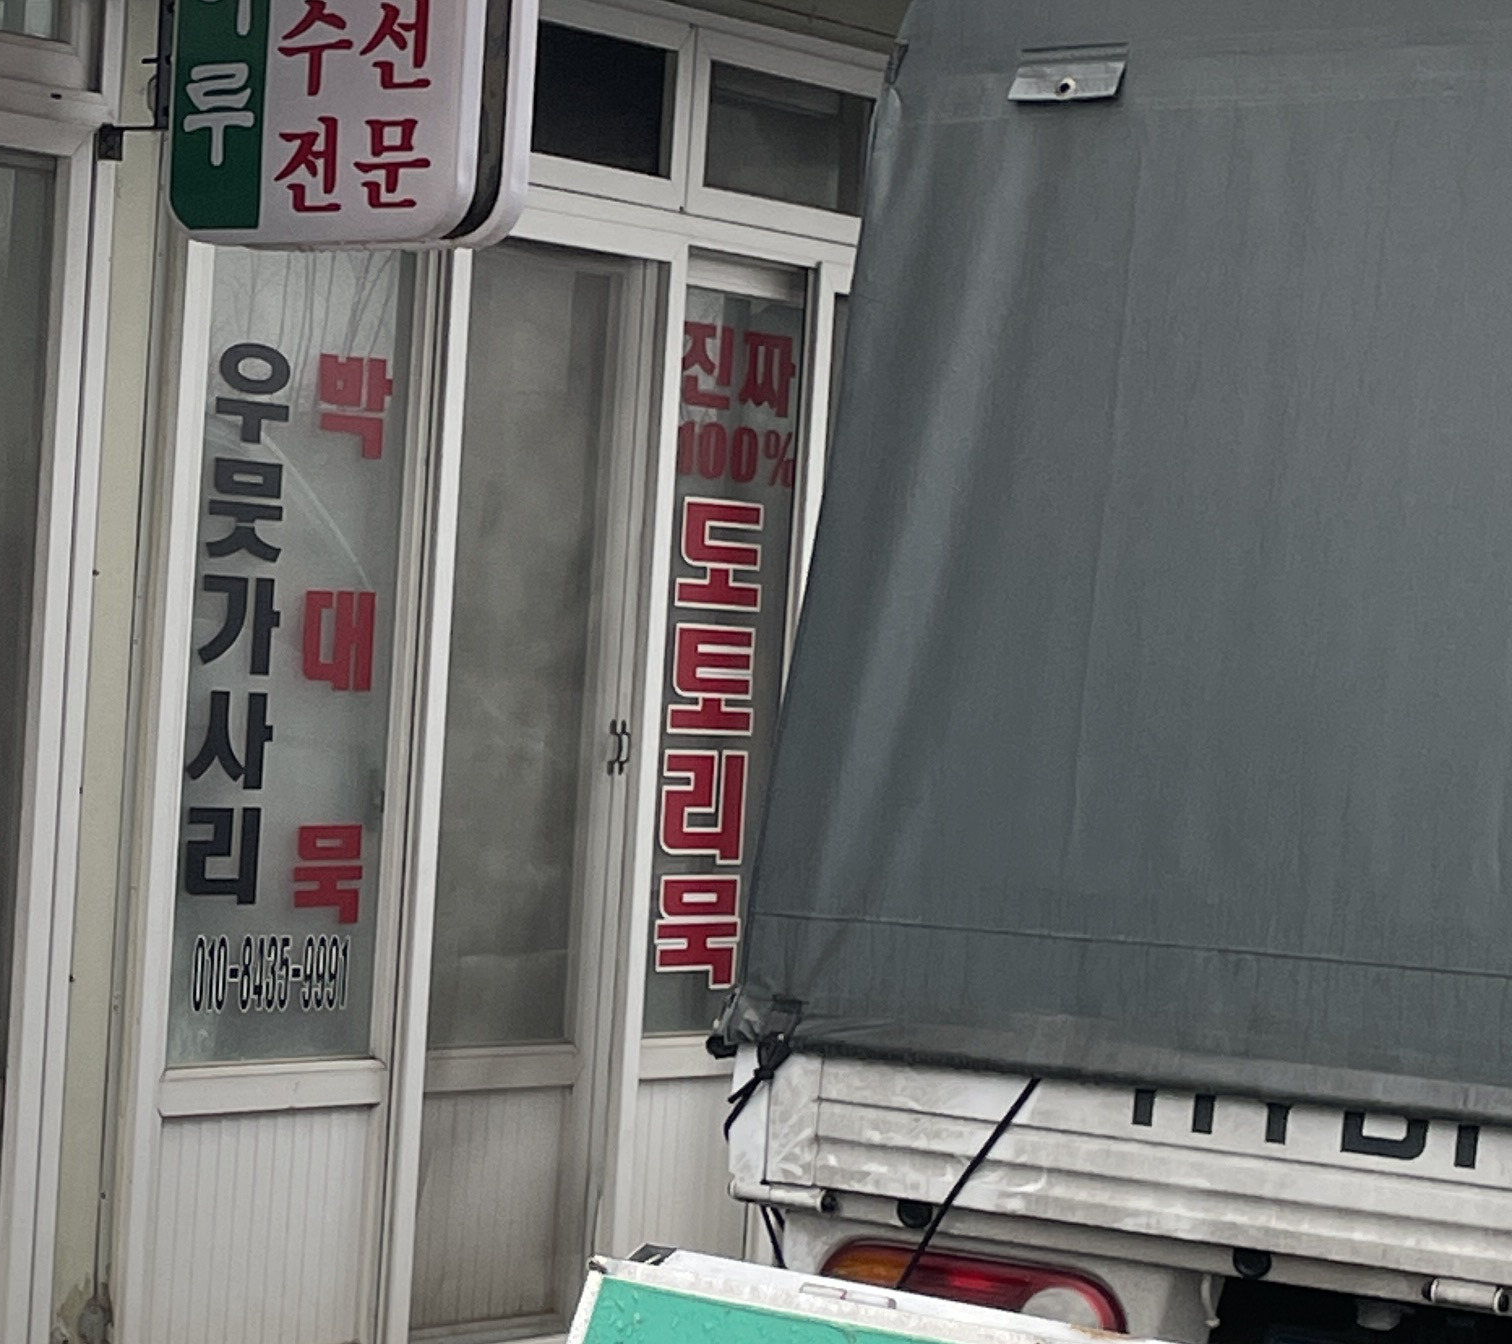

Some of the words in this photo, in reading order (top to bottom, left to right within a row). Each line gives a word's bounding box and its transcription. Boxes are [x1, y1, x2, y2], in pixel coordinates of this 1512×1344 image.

[274, 116, 431, 213] 전문
[682, 320, 796, 418] 진짜
[678, 419, 795, 488] 100%
[186, 343, 291, 906] 우뭇가사리
[655, 497, 764, 989] 도토리묵
[191, 934, 351, 1013] 010-8435-9991
